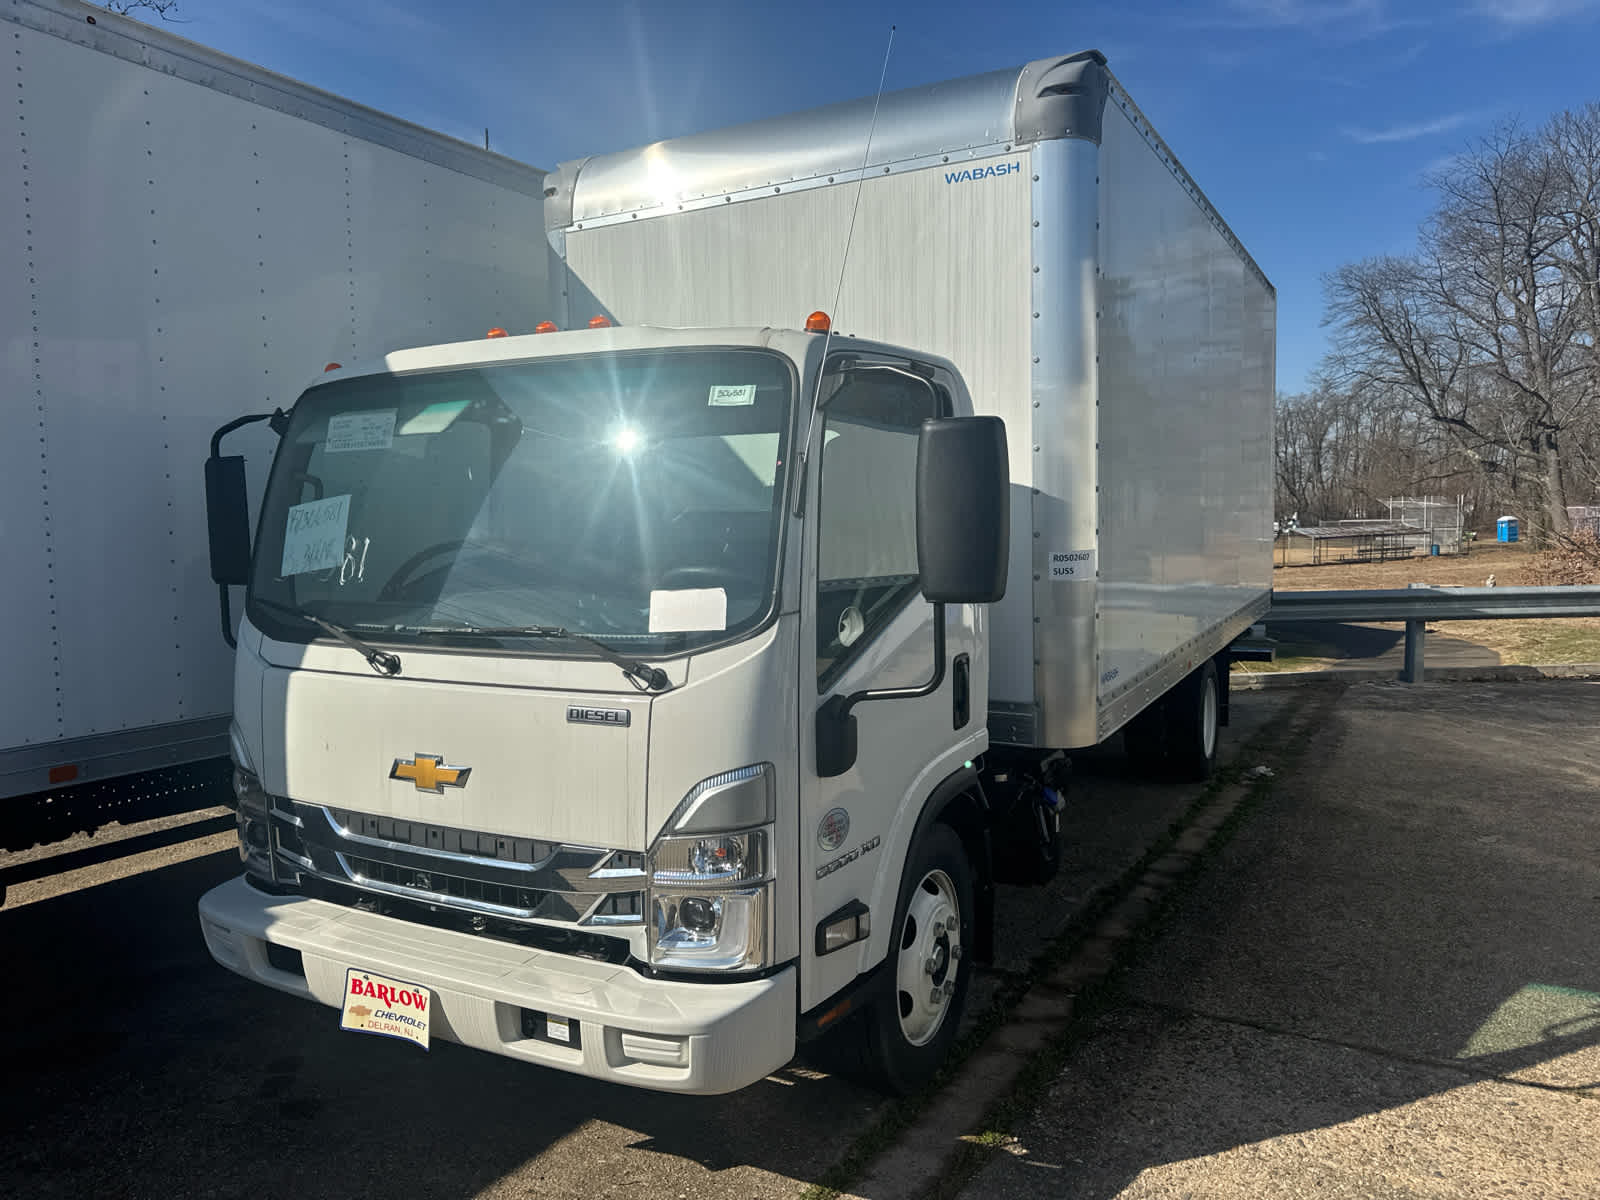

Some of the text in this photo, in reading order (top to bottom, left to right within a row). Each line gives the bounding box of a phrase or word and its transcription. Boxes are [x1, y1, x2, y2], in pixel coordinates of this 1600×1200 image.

[944, 161, 1020, 184] WABASH
[569, 708, 625, 723] DIESEL
[350, 978, 428, 1012] BARLOW
[374, 1009, 427, 1031] CHEVROLET
